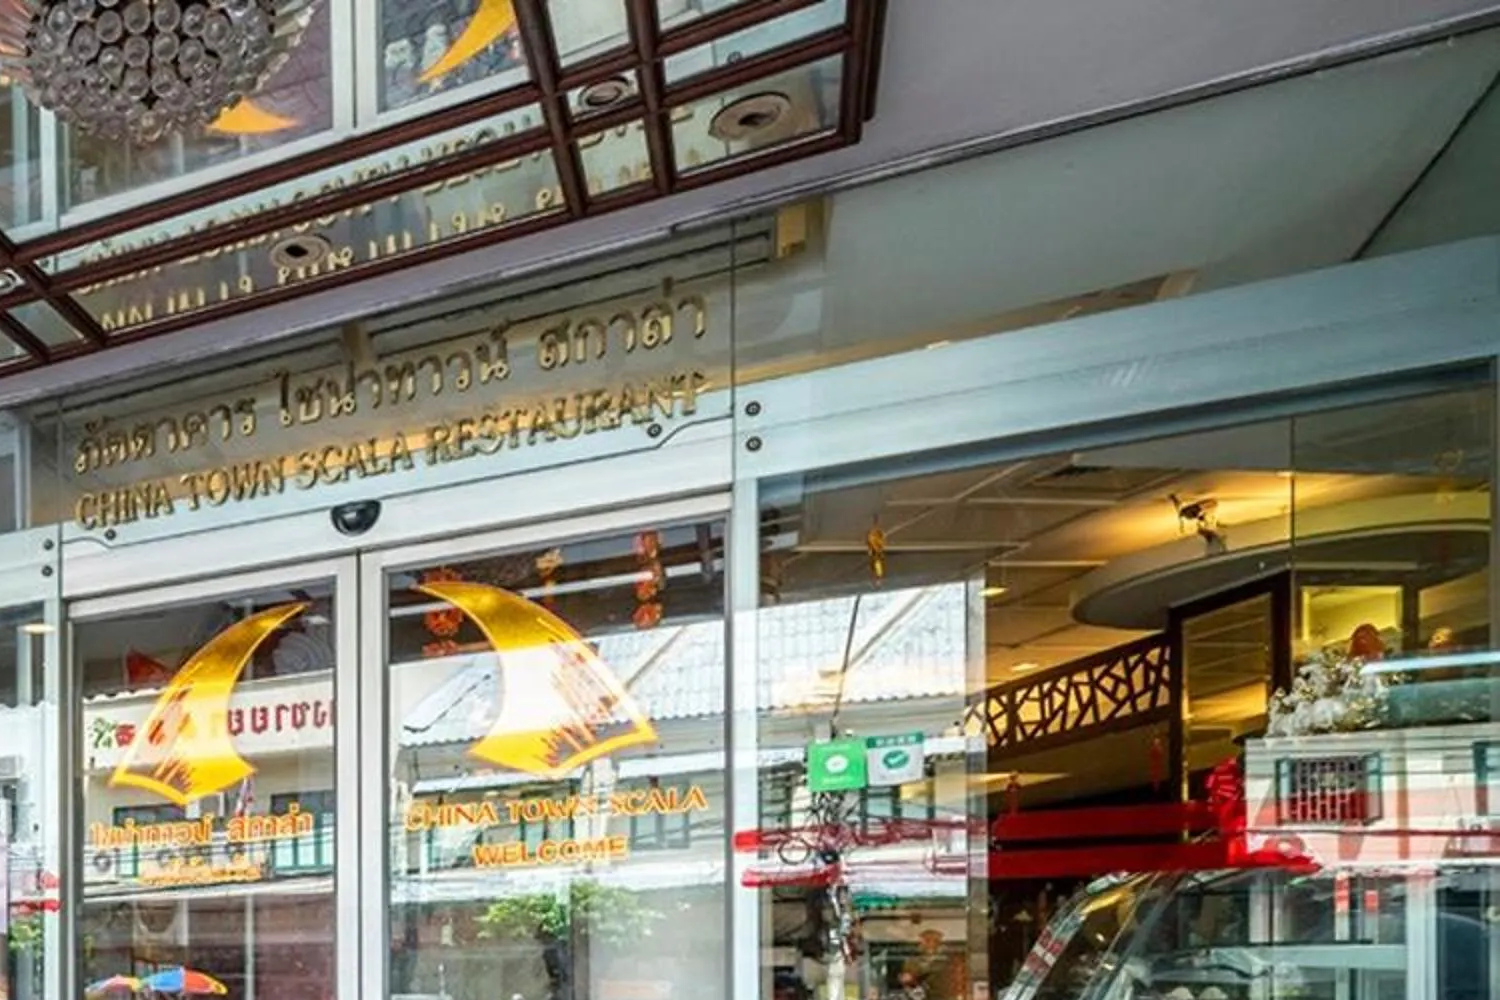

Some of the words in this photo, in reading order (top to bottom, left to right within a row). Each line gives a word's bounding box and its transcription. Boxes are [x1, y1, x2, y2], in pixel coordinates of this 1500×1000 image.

[74, 399, 256, 476] ภัตตาคาร
[537, 277, 708, 370] สกาล่า
[75, 480, 175, 531] CHINA
[180, 456, 286, 511] TOWN
[295, 430, 414, 490] SCALA
[426, 371, 710, 465] RESTAURANT
[404, 800, 498, 832] CHINA
[506, 794, 598, 824] TOWN
[607, 785, 709, 818] SCALA
[472, 835, 629, 869] WELCOME
